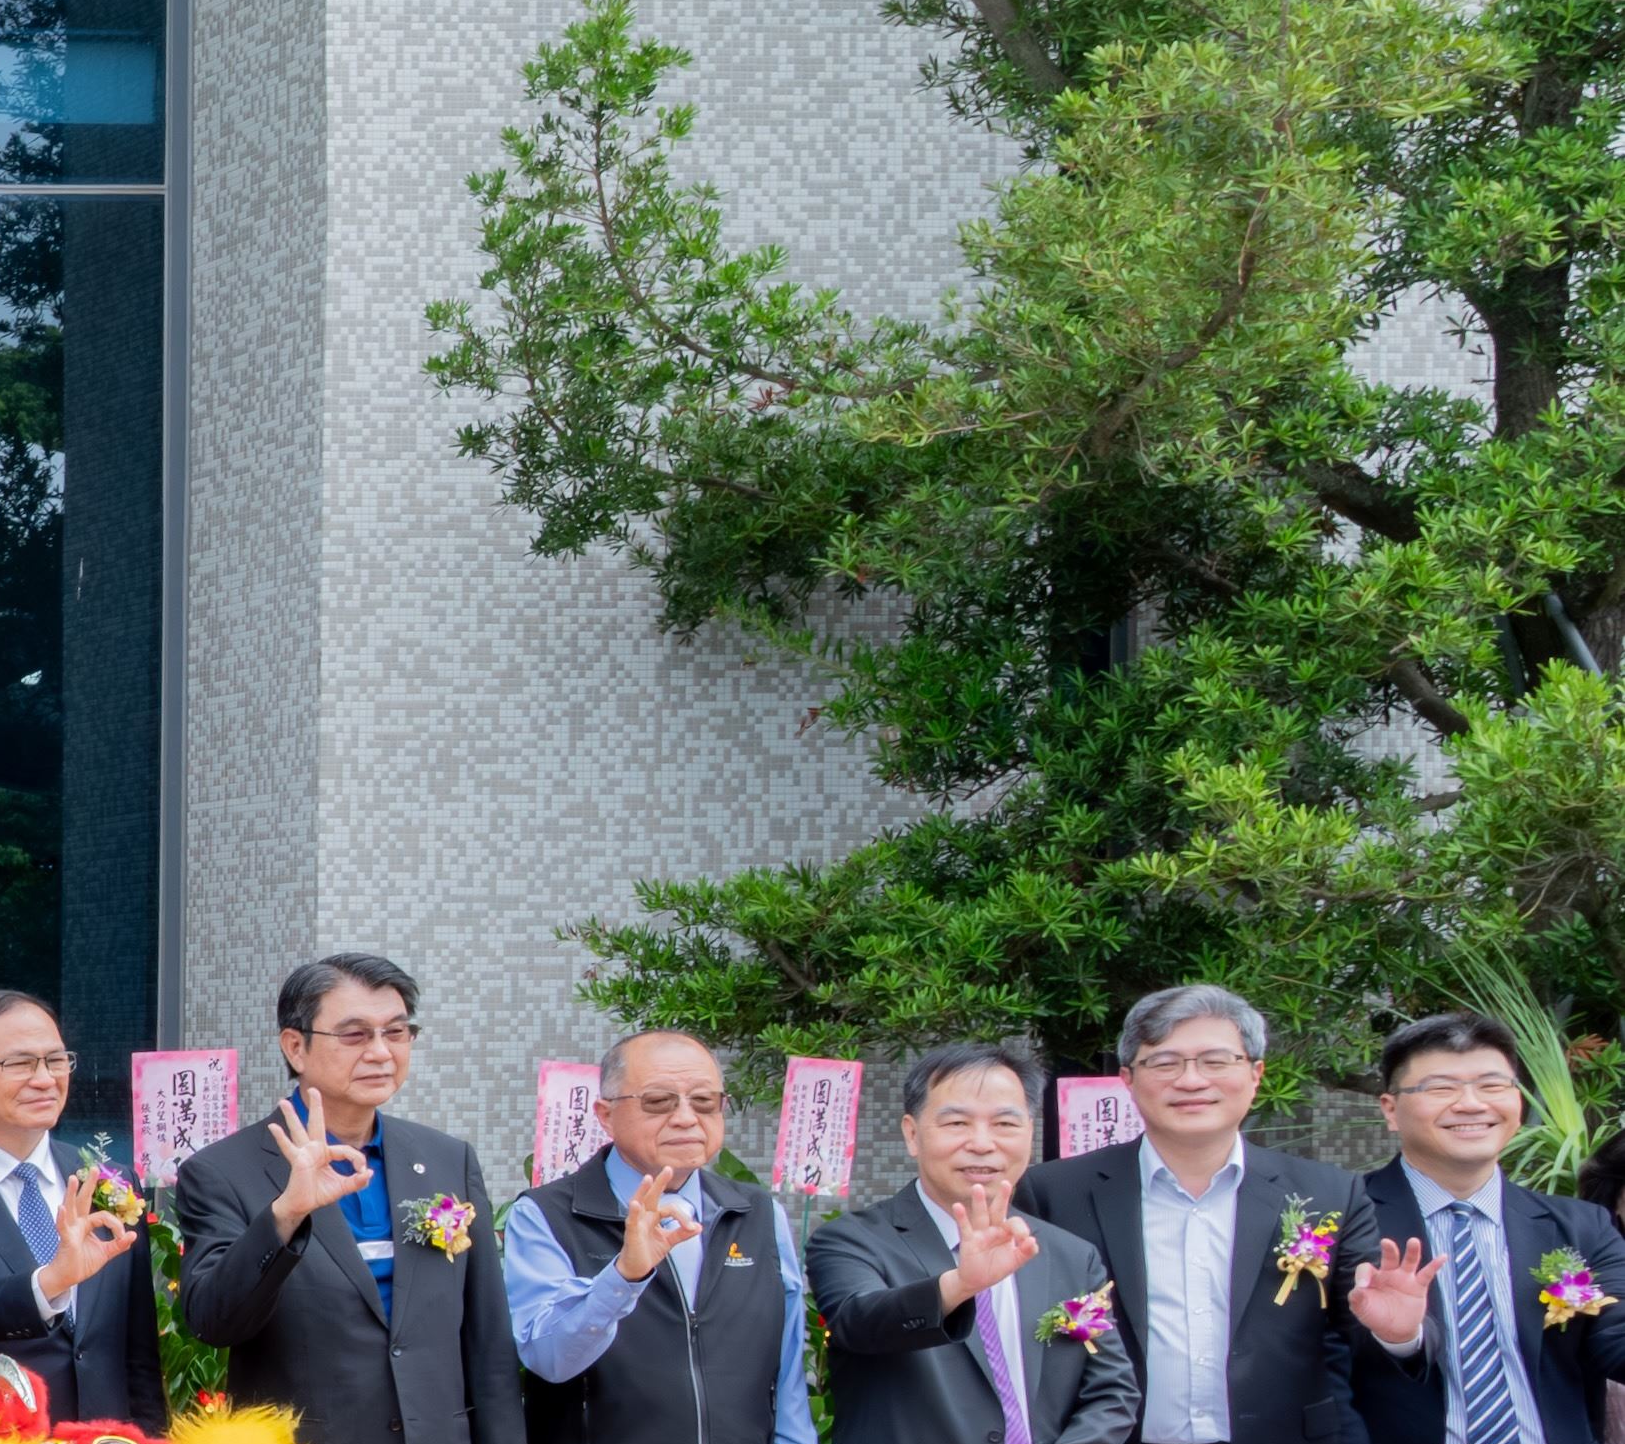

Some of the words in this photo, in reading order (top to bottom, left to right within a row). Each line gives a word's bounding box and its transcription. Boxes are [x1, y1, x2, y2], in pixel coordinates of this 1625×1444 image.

[172, 1069, 197, 1168] 圓滿成
[564, 1086, 589, 1177] 圓滿成
[804, 1079, 831, 1187] 圓滿成功
